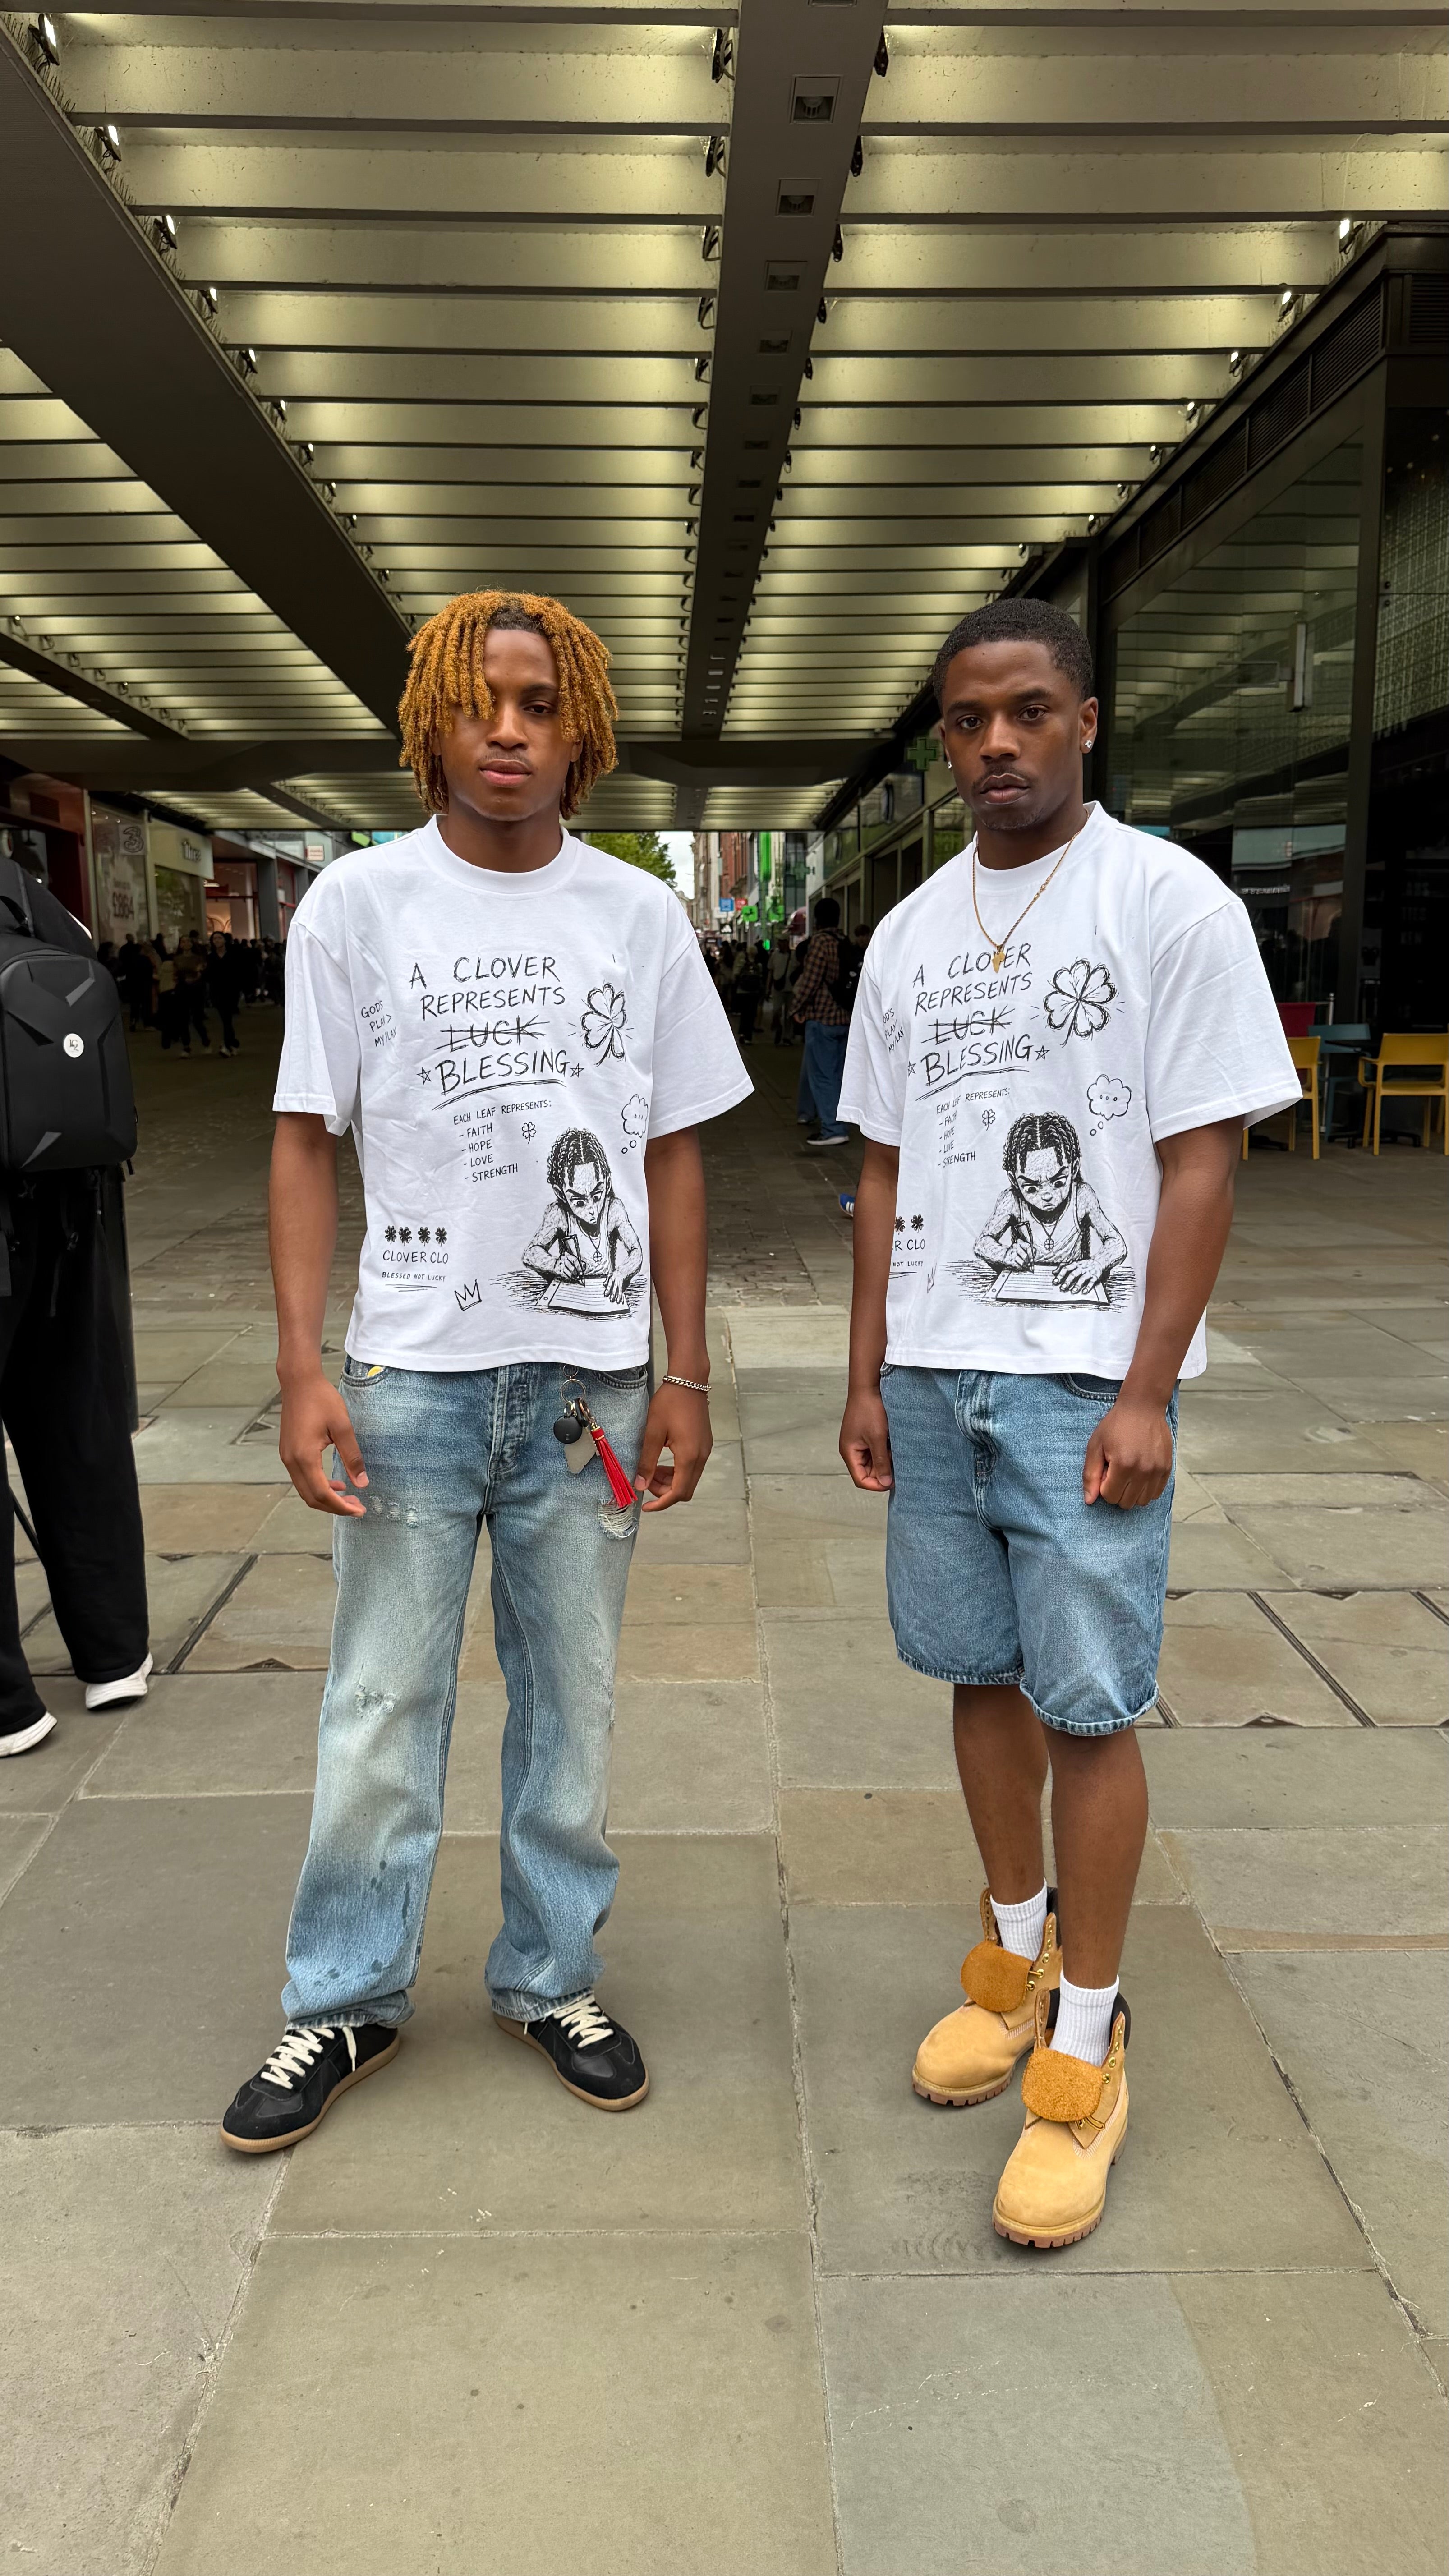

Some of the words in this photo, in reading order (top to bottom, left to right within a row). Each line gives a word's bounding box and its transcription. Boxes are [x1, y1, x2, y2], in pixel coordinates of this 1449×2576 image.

[409, 962, 427, 989] A
[453, 954, 561, 983] CLOVER
[912, 964, 925, 989] A
[947, 943, 1032, 980] CLOER
[420, 984, 566, 1021] REPRESENTS
[915, 971, 1033, 1017] REPRESENTS
[444, 1015, 544, 1052] LUCK
[883, 1008, 894, 1024] OD'S
[930, 1005, 1010, 1045] LUCK
[375, 1035, 384, 1047] MY
[435, 1049, 570, 1095] BLESSING
[920, 1033, 1034, 1086] BLESSING
[453, 1112, 471, 1125] EACH
[477, 1106, 497, 1119] LEAF
[501, 1099, 552, 1114] REPRESENTS:
[937, 1101, 950, 1114] EACH
[965, 1087, 1010, 1102] REPRESENTS:
[382, 1250, 427, 1263] CLOVER
[430, 1252, 449, 1264] CLO
[906, 1238, 925, 1251] CLO
